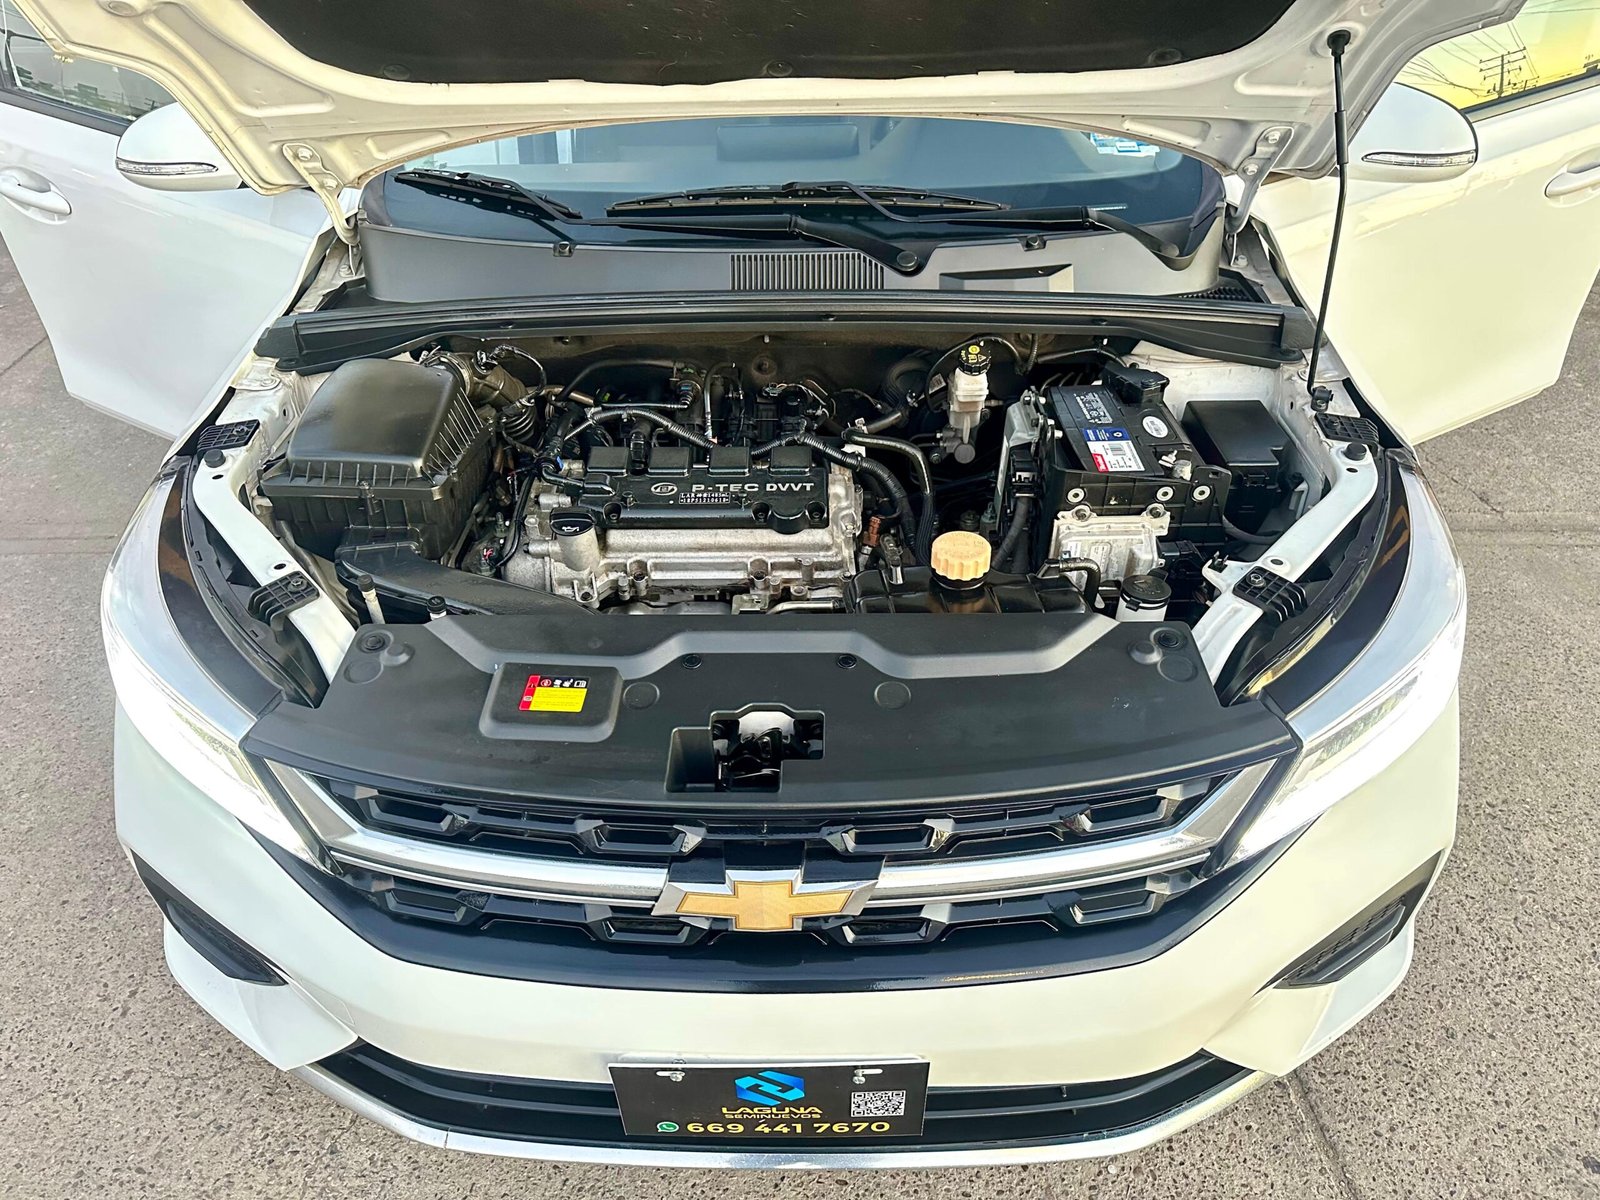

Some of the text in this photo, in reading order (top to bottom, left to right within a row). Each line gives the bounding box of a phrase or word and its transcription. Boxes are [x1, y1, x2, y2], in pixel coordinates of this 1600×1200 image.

[691, 482, 815, 493] P-TEC DVVT
[721, 1106, 823, 1114] LAGUNA
[686, 1121, 890, 1133] 669 441 7670
